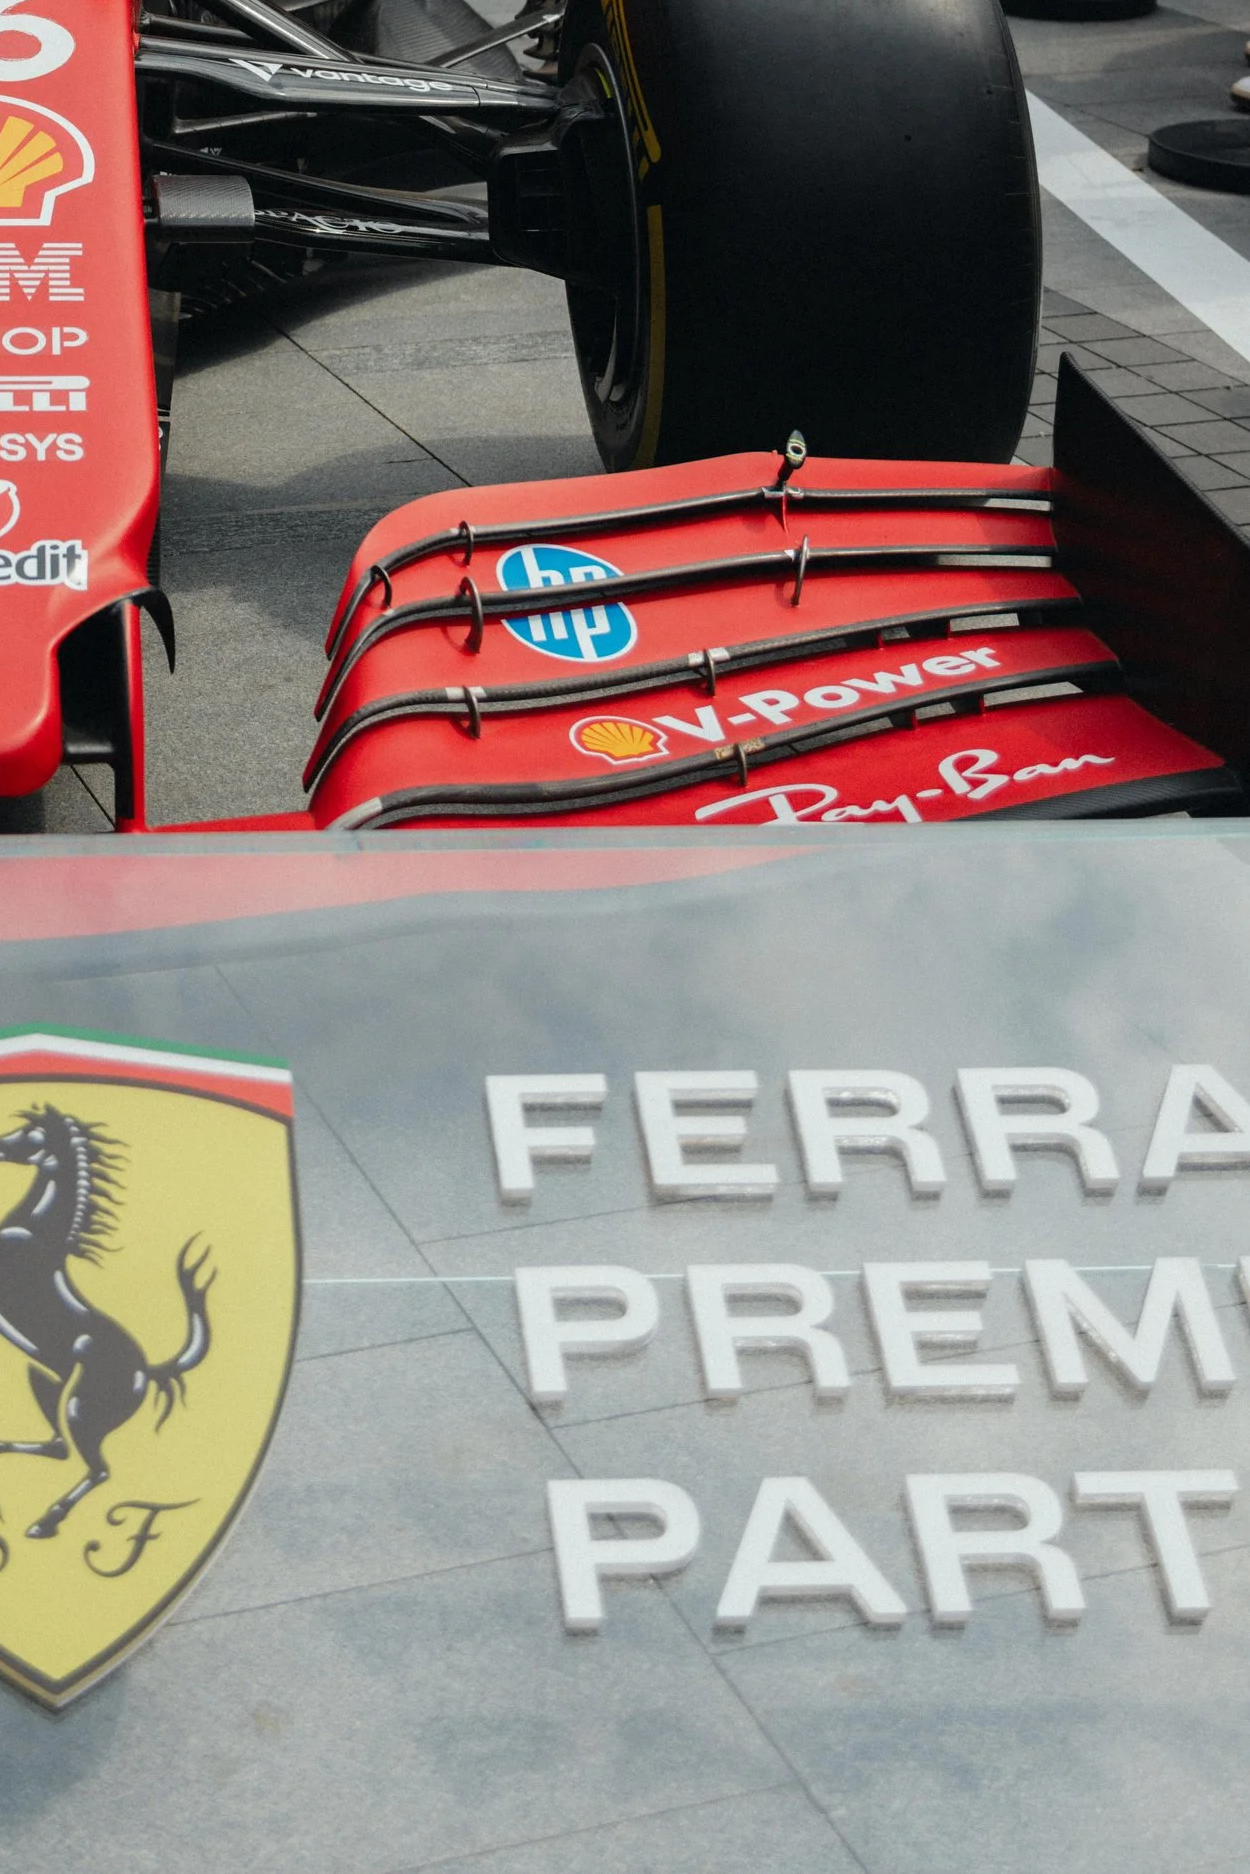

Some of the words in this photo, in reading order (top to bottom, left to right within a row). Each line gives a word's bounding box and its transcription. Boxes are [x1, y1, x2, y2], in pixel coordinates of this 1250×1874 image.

[289, 67, 454, 92] vantage
[519, 546, 613, 661] hp
[653, 642, 1004, 744] V-Power
[514, 1256, 1250, 1402] PREM
[547, 1468, 1241, 1628] PART
